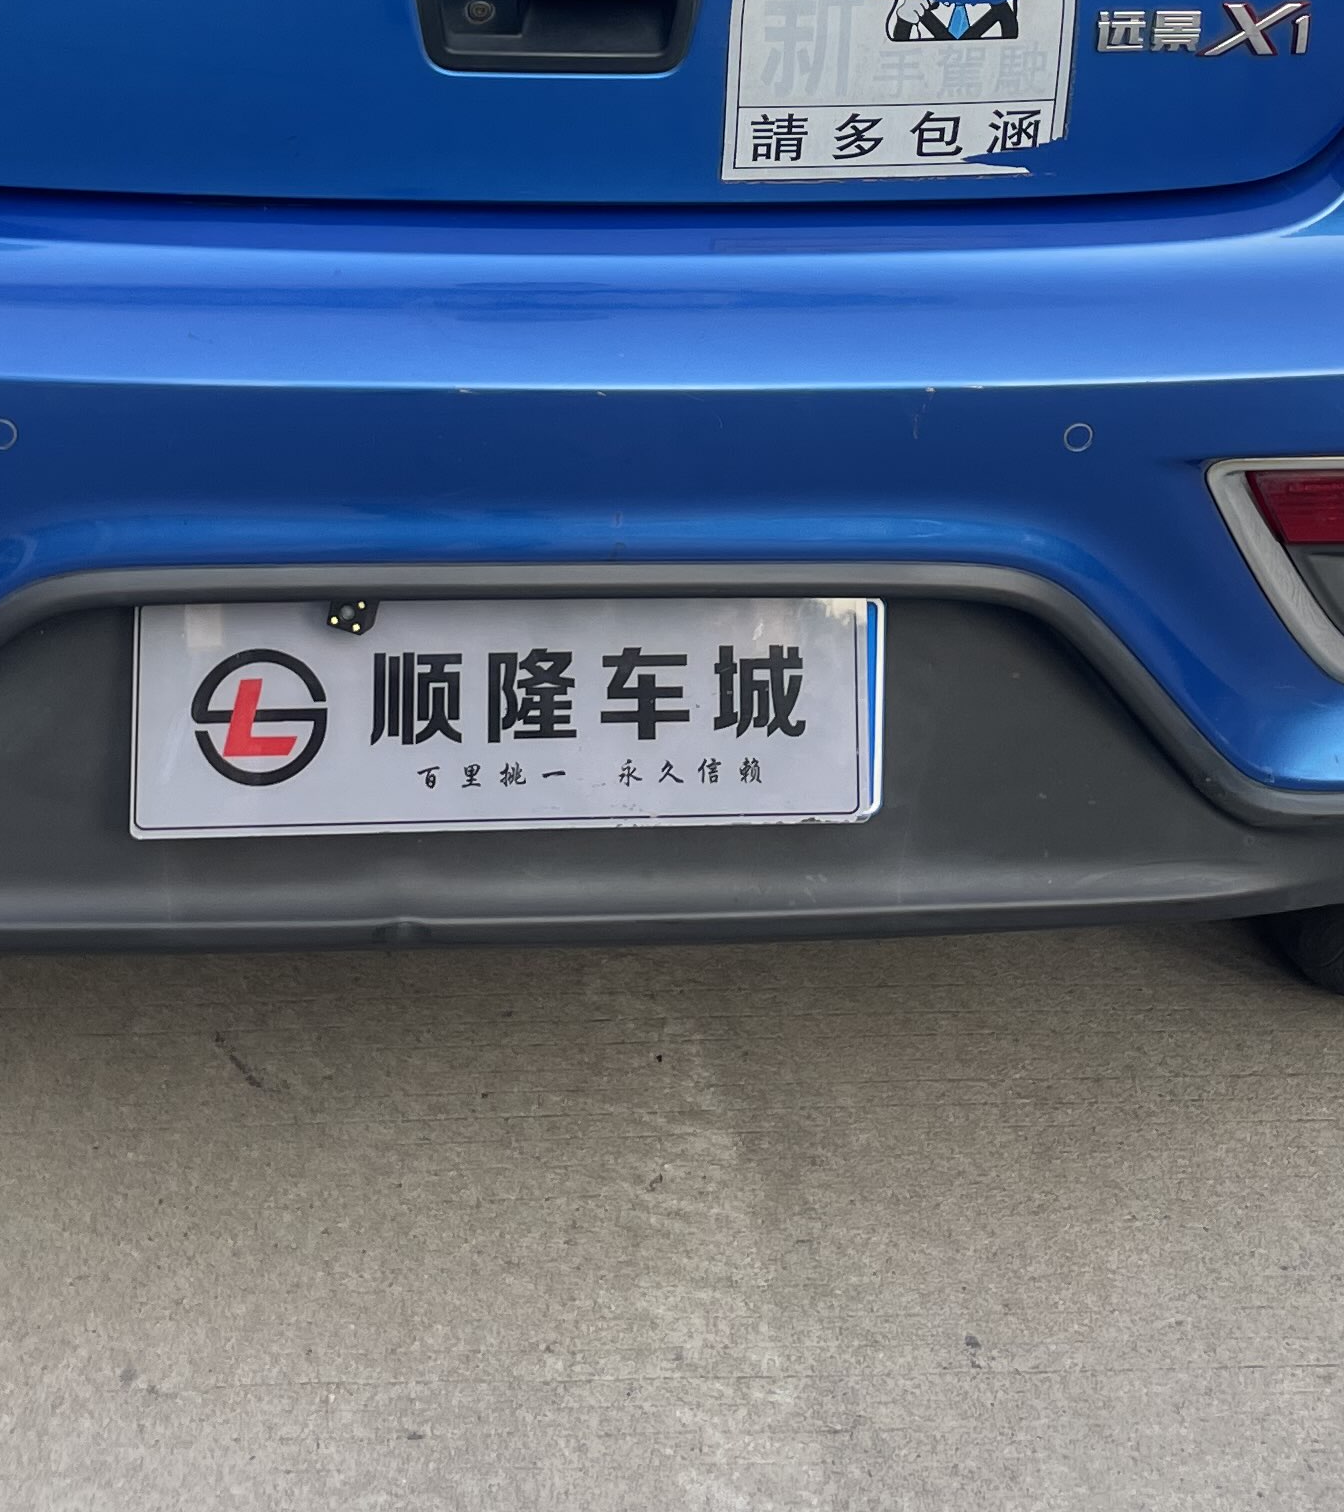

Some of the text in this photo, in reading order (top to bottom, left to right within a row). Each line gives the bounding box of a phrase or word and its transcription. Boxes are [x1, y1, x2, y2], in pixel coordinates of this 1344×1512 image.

[1096, 0, 1312, 56] 远景 X1
[749, 109, 1043, 162] 請多包涵
[368, 644, 808, 746] 顺隆车城
[415, 757, 765, 791] 百里挑一 永久信赖
